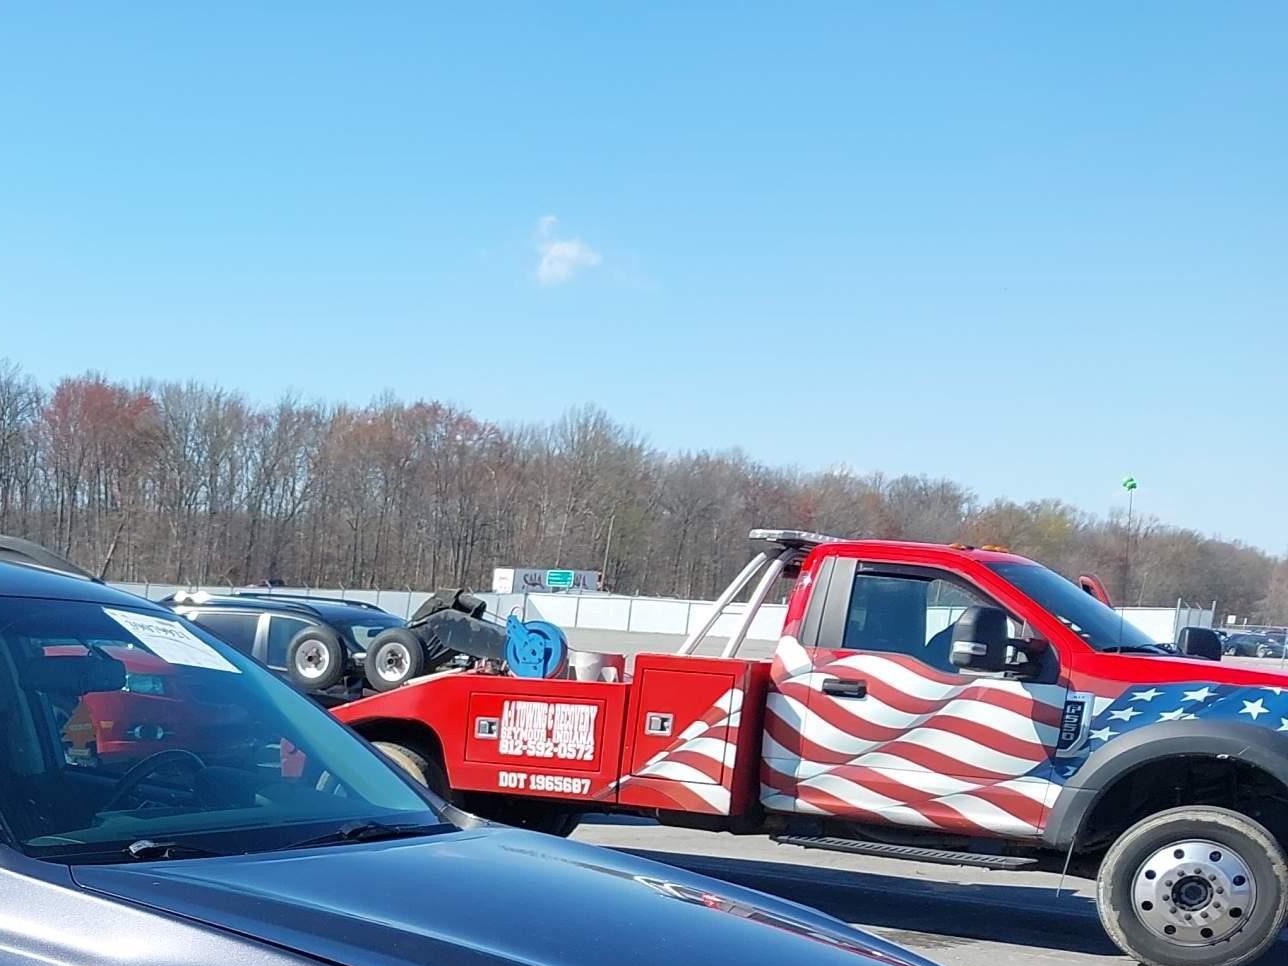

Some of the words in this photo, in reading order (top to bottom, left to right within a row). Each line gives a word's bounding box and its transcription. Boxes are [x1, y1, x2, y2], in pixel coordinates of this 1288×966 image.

[516, 701, 549, 730] TOWING
[554, 703, 598, 733] RECOVERY
[552, 729, 594, 745] INDIANA
[499, 739, 594, 761] 812-592-0572
[498, 771, 527, 789] DOT
[529, 774, 591, 795] 1965687
